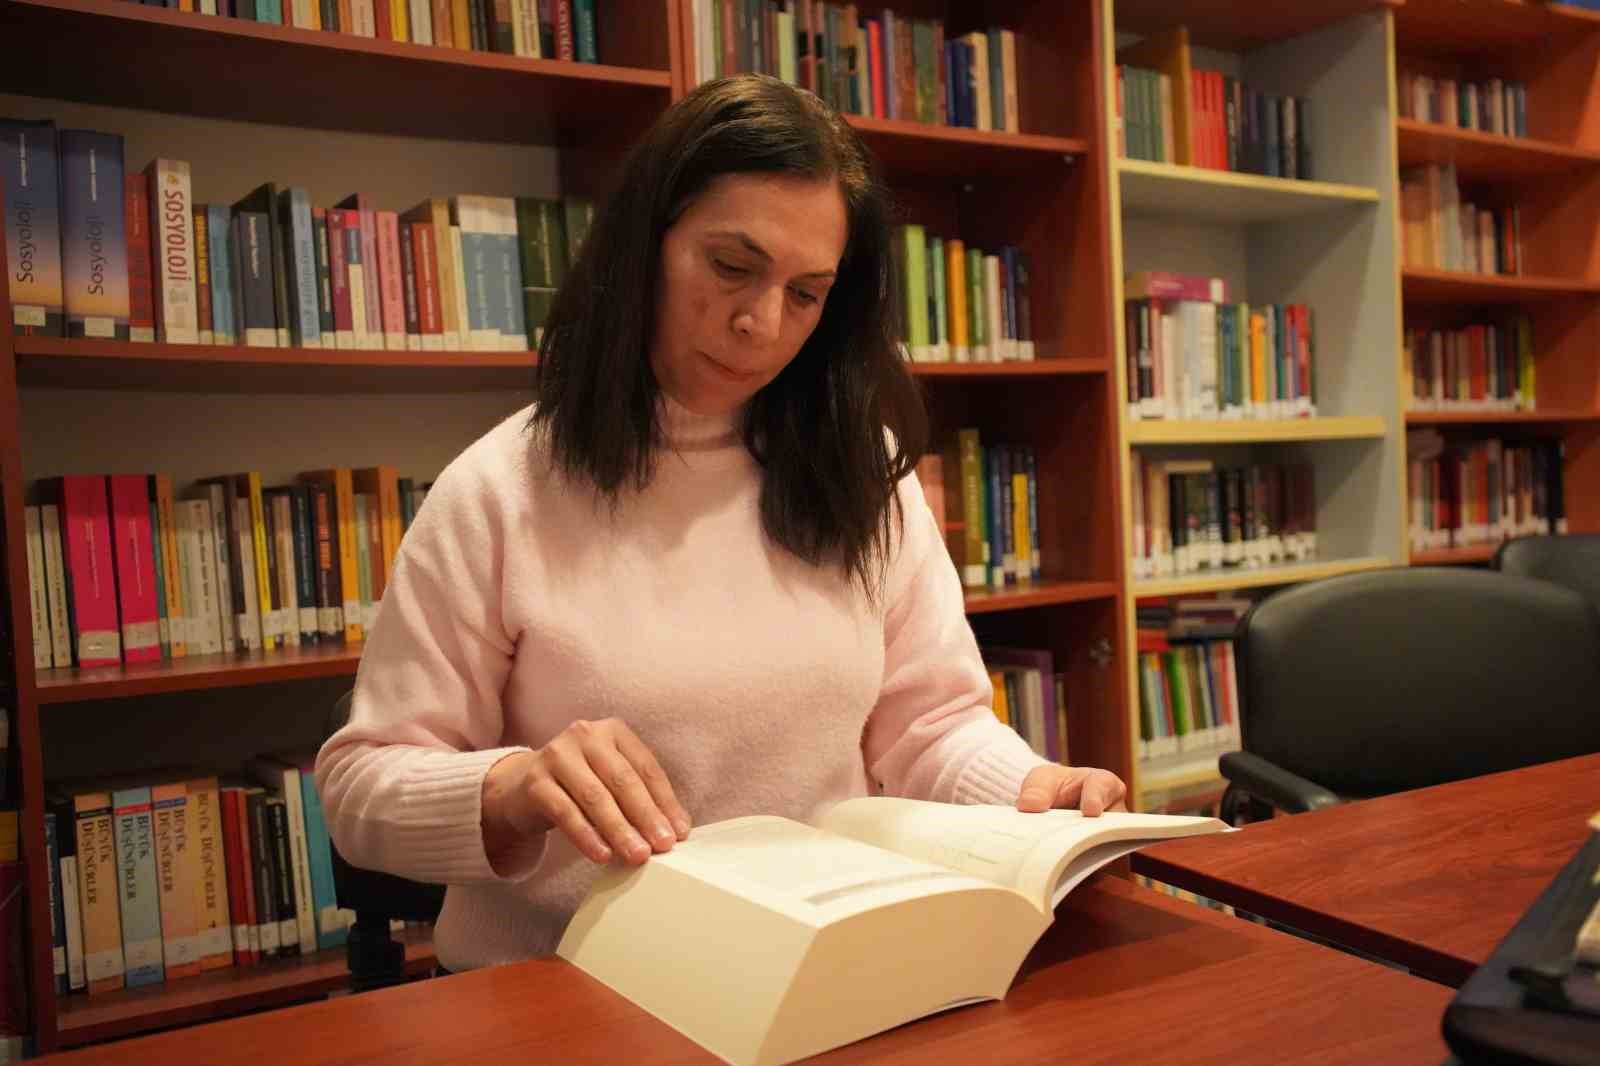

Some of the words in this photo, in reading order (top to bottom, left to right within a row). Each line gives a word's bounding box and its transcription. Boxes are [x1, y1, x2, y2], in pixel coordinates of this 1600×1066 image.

[16, 200, 38, 283] Sosyoloji
[86, 215, 106, 296] Sosyoloji
[164, 190, 192, 282] SOSYOLOJİ
